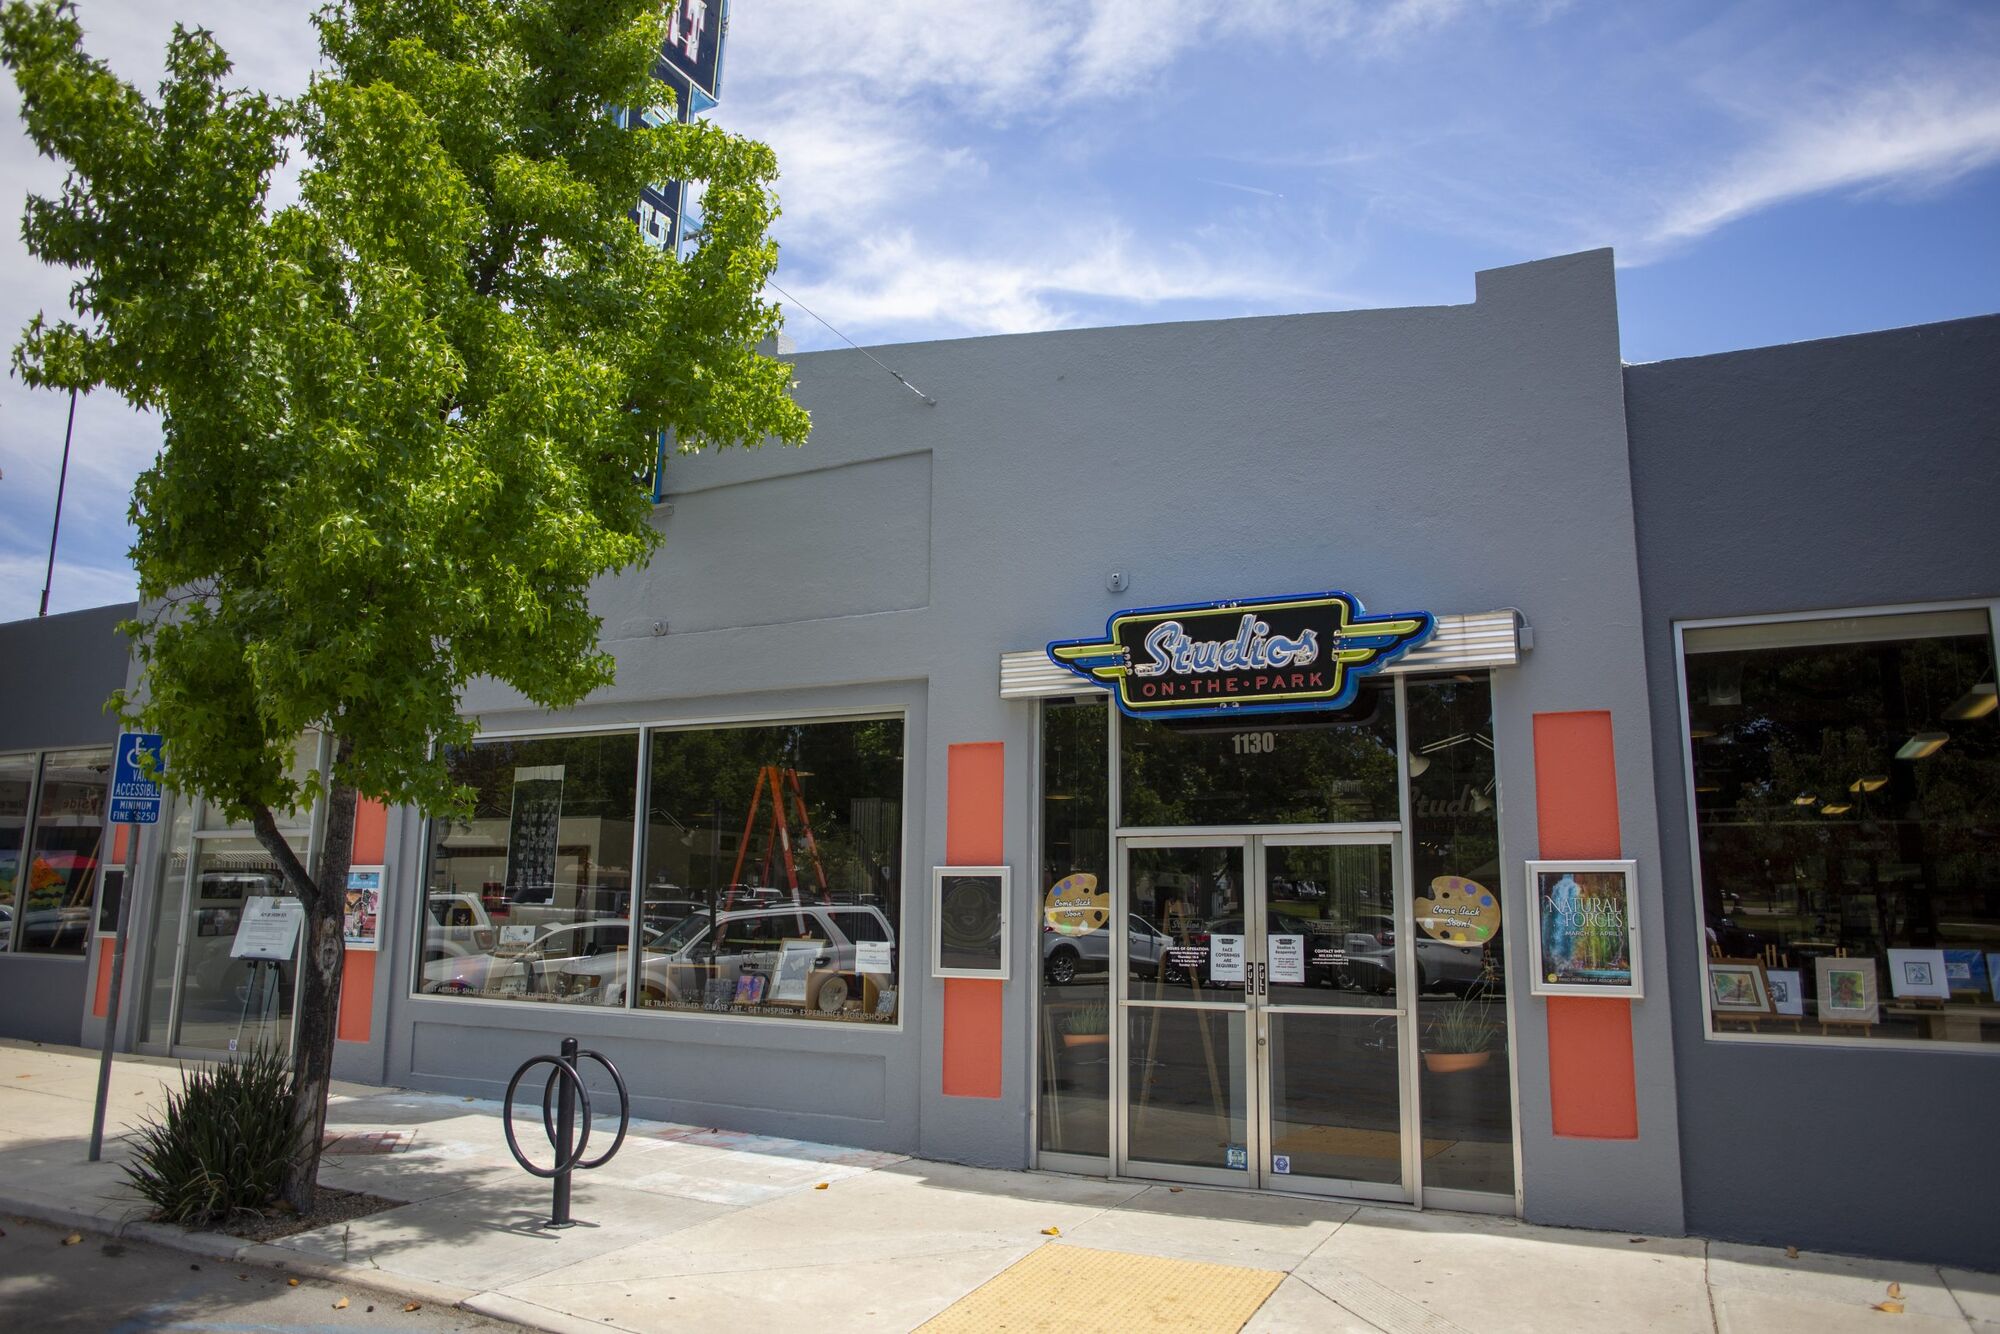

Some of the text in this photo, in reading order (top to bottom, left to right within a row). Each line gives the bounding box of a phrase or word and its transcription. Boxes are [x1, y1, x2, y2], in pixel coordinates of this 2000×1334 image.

[1134, 614, 1318, 677] Studios
[1142, 672, 1323, 697] ON THE PARK
[1231, 731, 1275, 756] 1130
[115, 783, 160, 797] ACCESSIBLE
[120, 801, 152, 810] MINIMUM
[113, 811, 156, 821] FINE $250
[1432, 904, 1480, 916] Come Back
[1544, 895, 1622, 915] NATURAL
[1446, 916, 1473, 928] Soon!
[1565, 912, 1623, 928] FORCES
[644, 999, 890, 1022] BE TRANSFORMED CREATE ART GET INSPIRED EXPERIENCE WORKSHOPS
